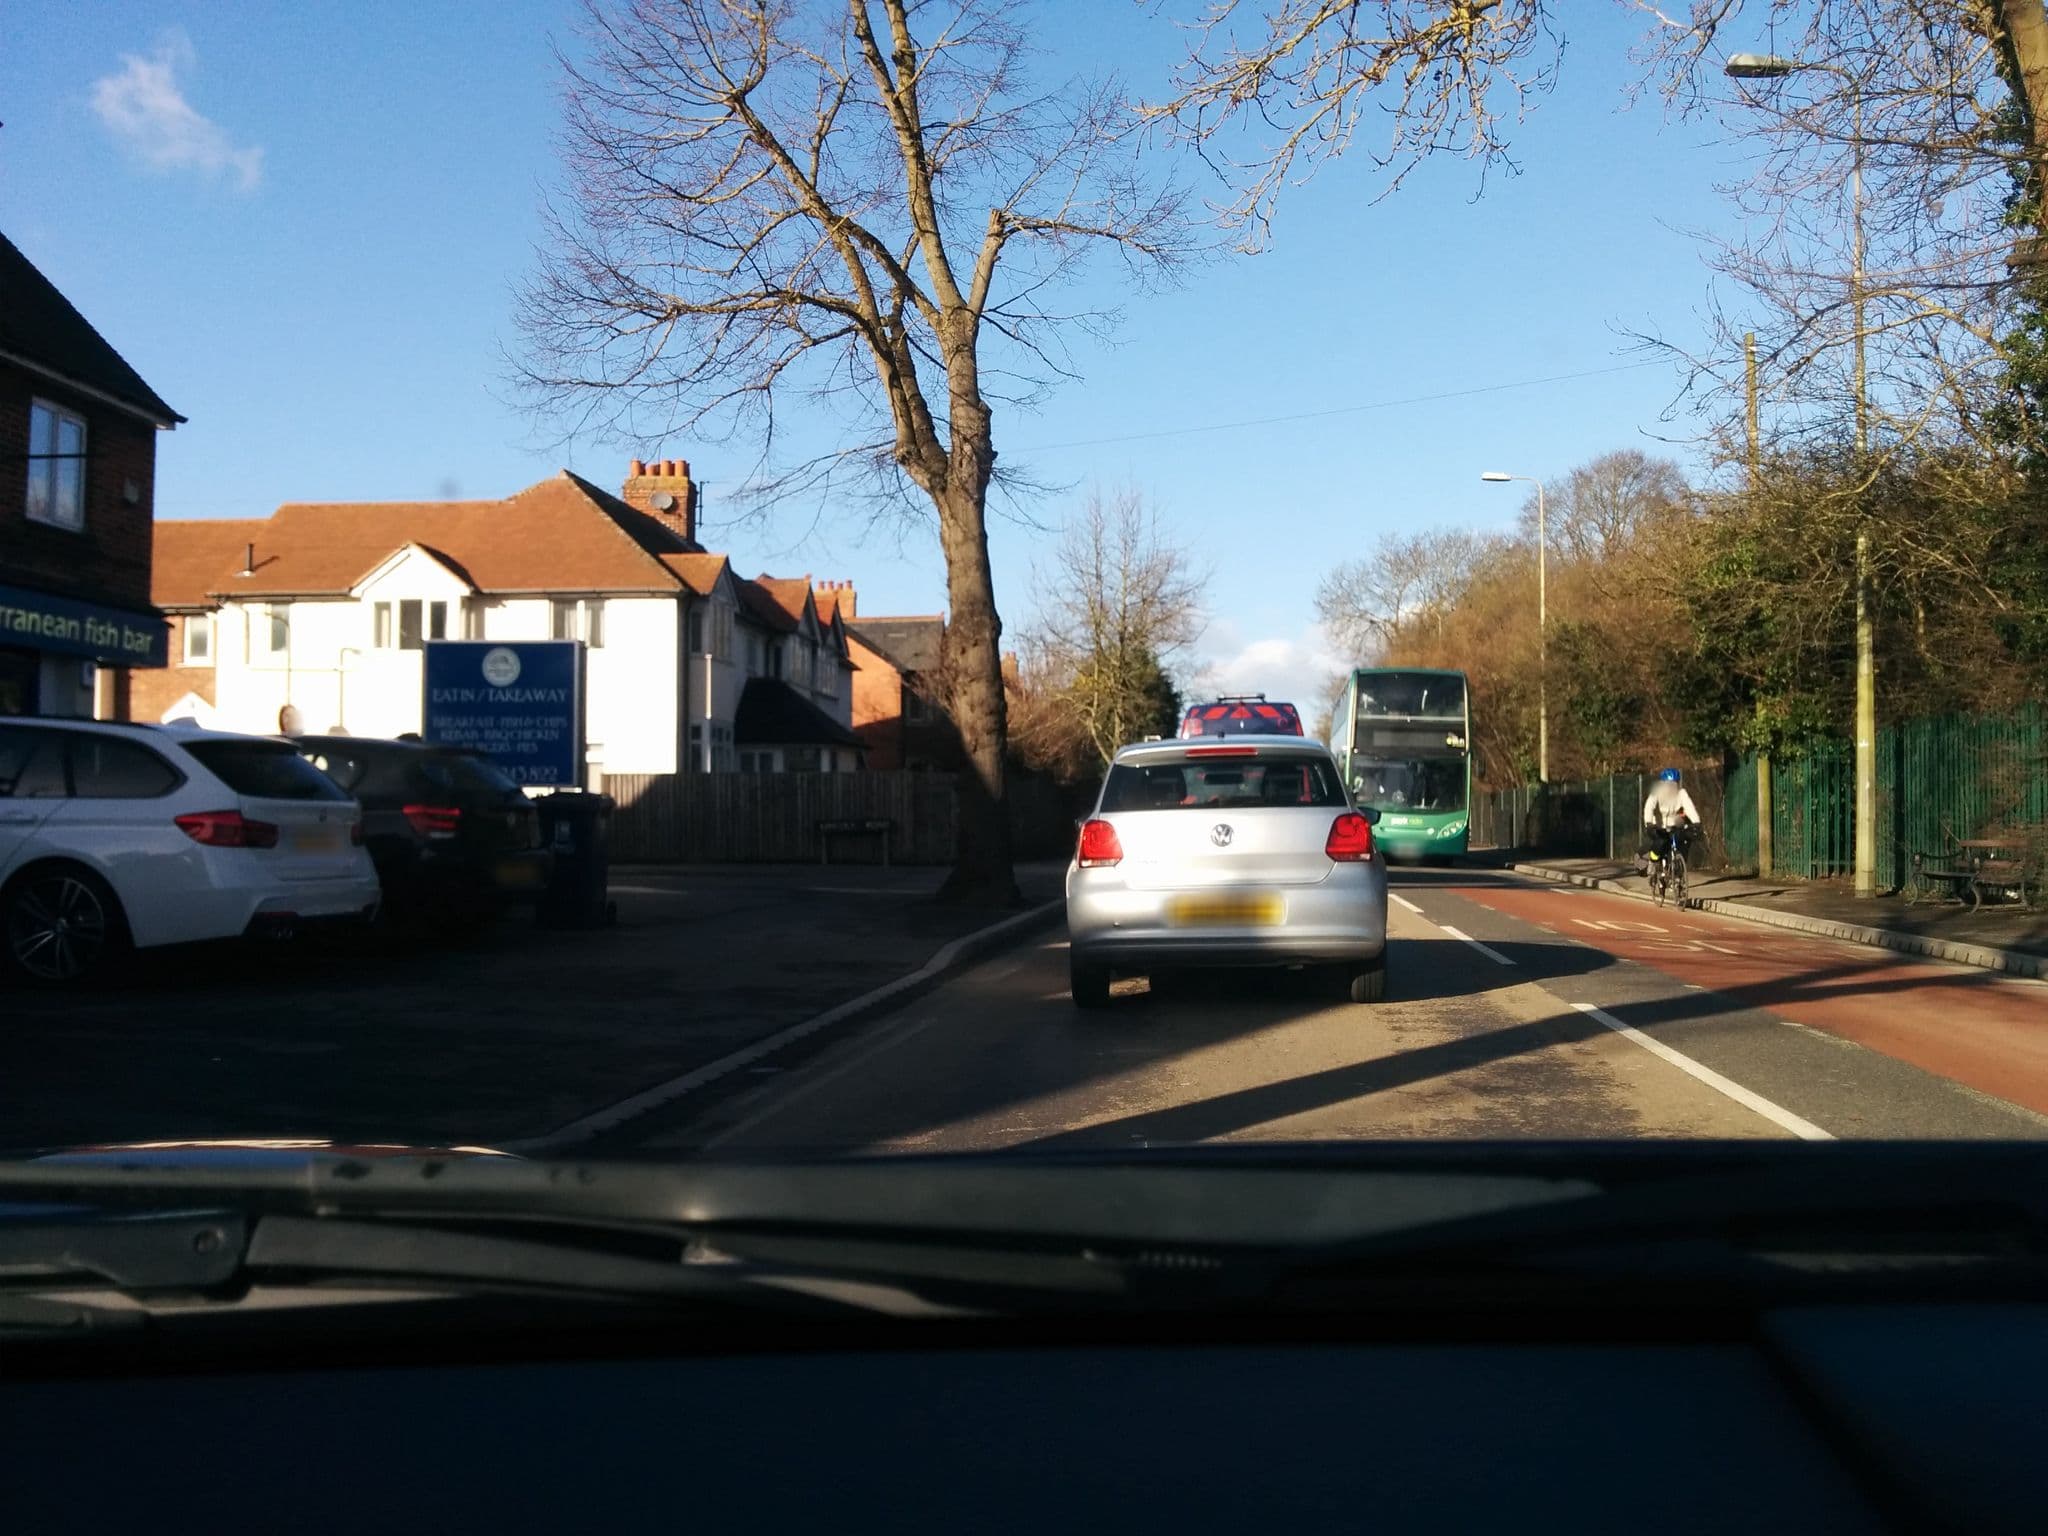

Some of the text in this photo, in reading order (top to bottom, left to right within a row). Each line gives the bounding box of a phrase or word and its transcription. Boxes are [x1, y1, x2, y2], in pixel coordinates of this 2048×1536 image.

[84, 617, 119, 648] fish
[122, 624, 154, 653] bar
[487, 688, 568, 703] TAKEAWAY
